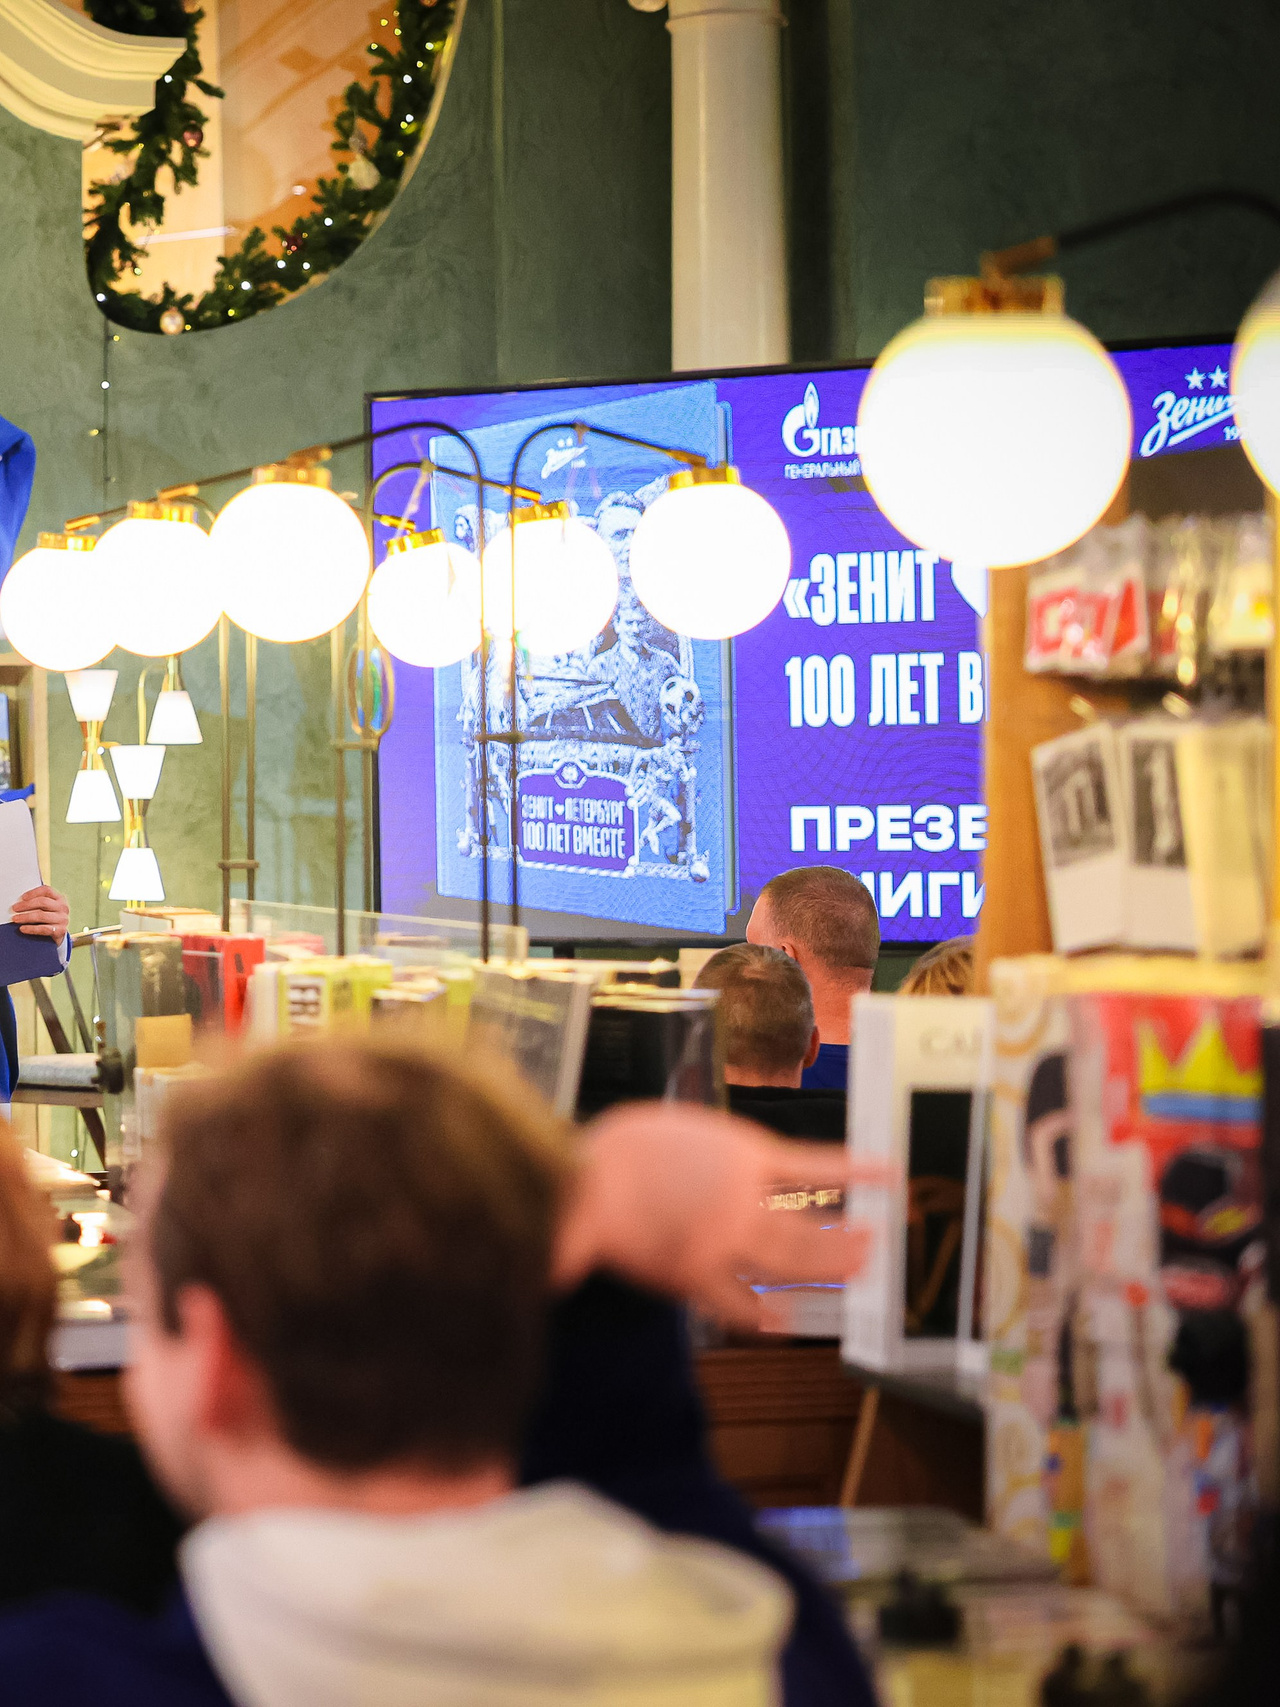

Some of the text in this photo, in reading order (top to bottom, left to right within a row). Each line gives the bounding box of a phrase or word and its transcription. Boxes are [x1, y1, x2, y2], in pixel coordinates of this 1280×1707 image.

[782, 549, 940, 627] «ЗЕНИТ
[784, 650, 990, 728] 100 ЛЕТ В
[521, 820, 627, 860] 100 ЛЕТ ВМЕСТЕ
[790, 803, 989, 853] ПРЕЗЕ
